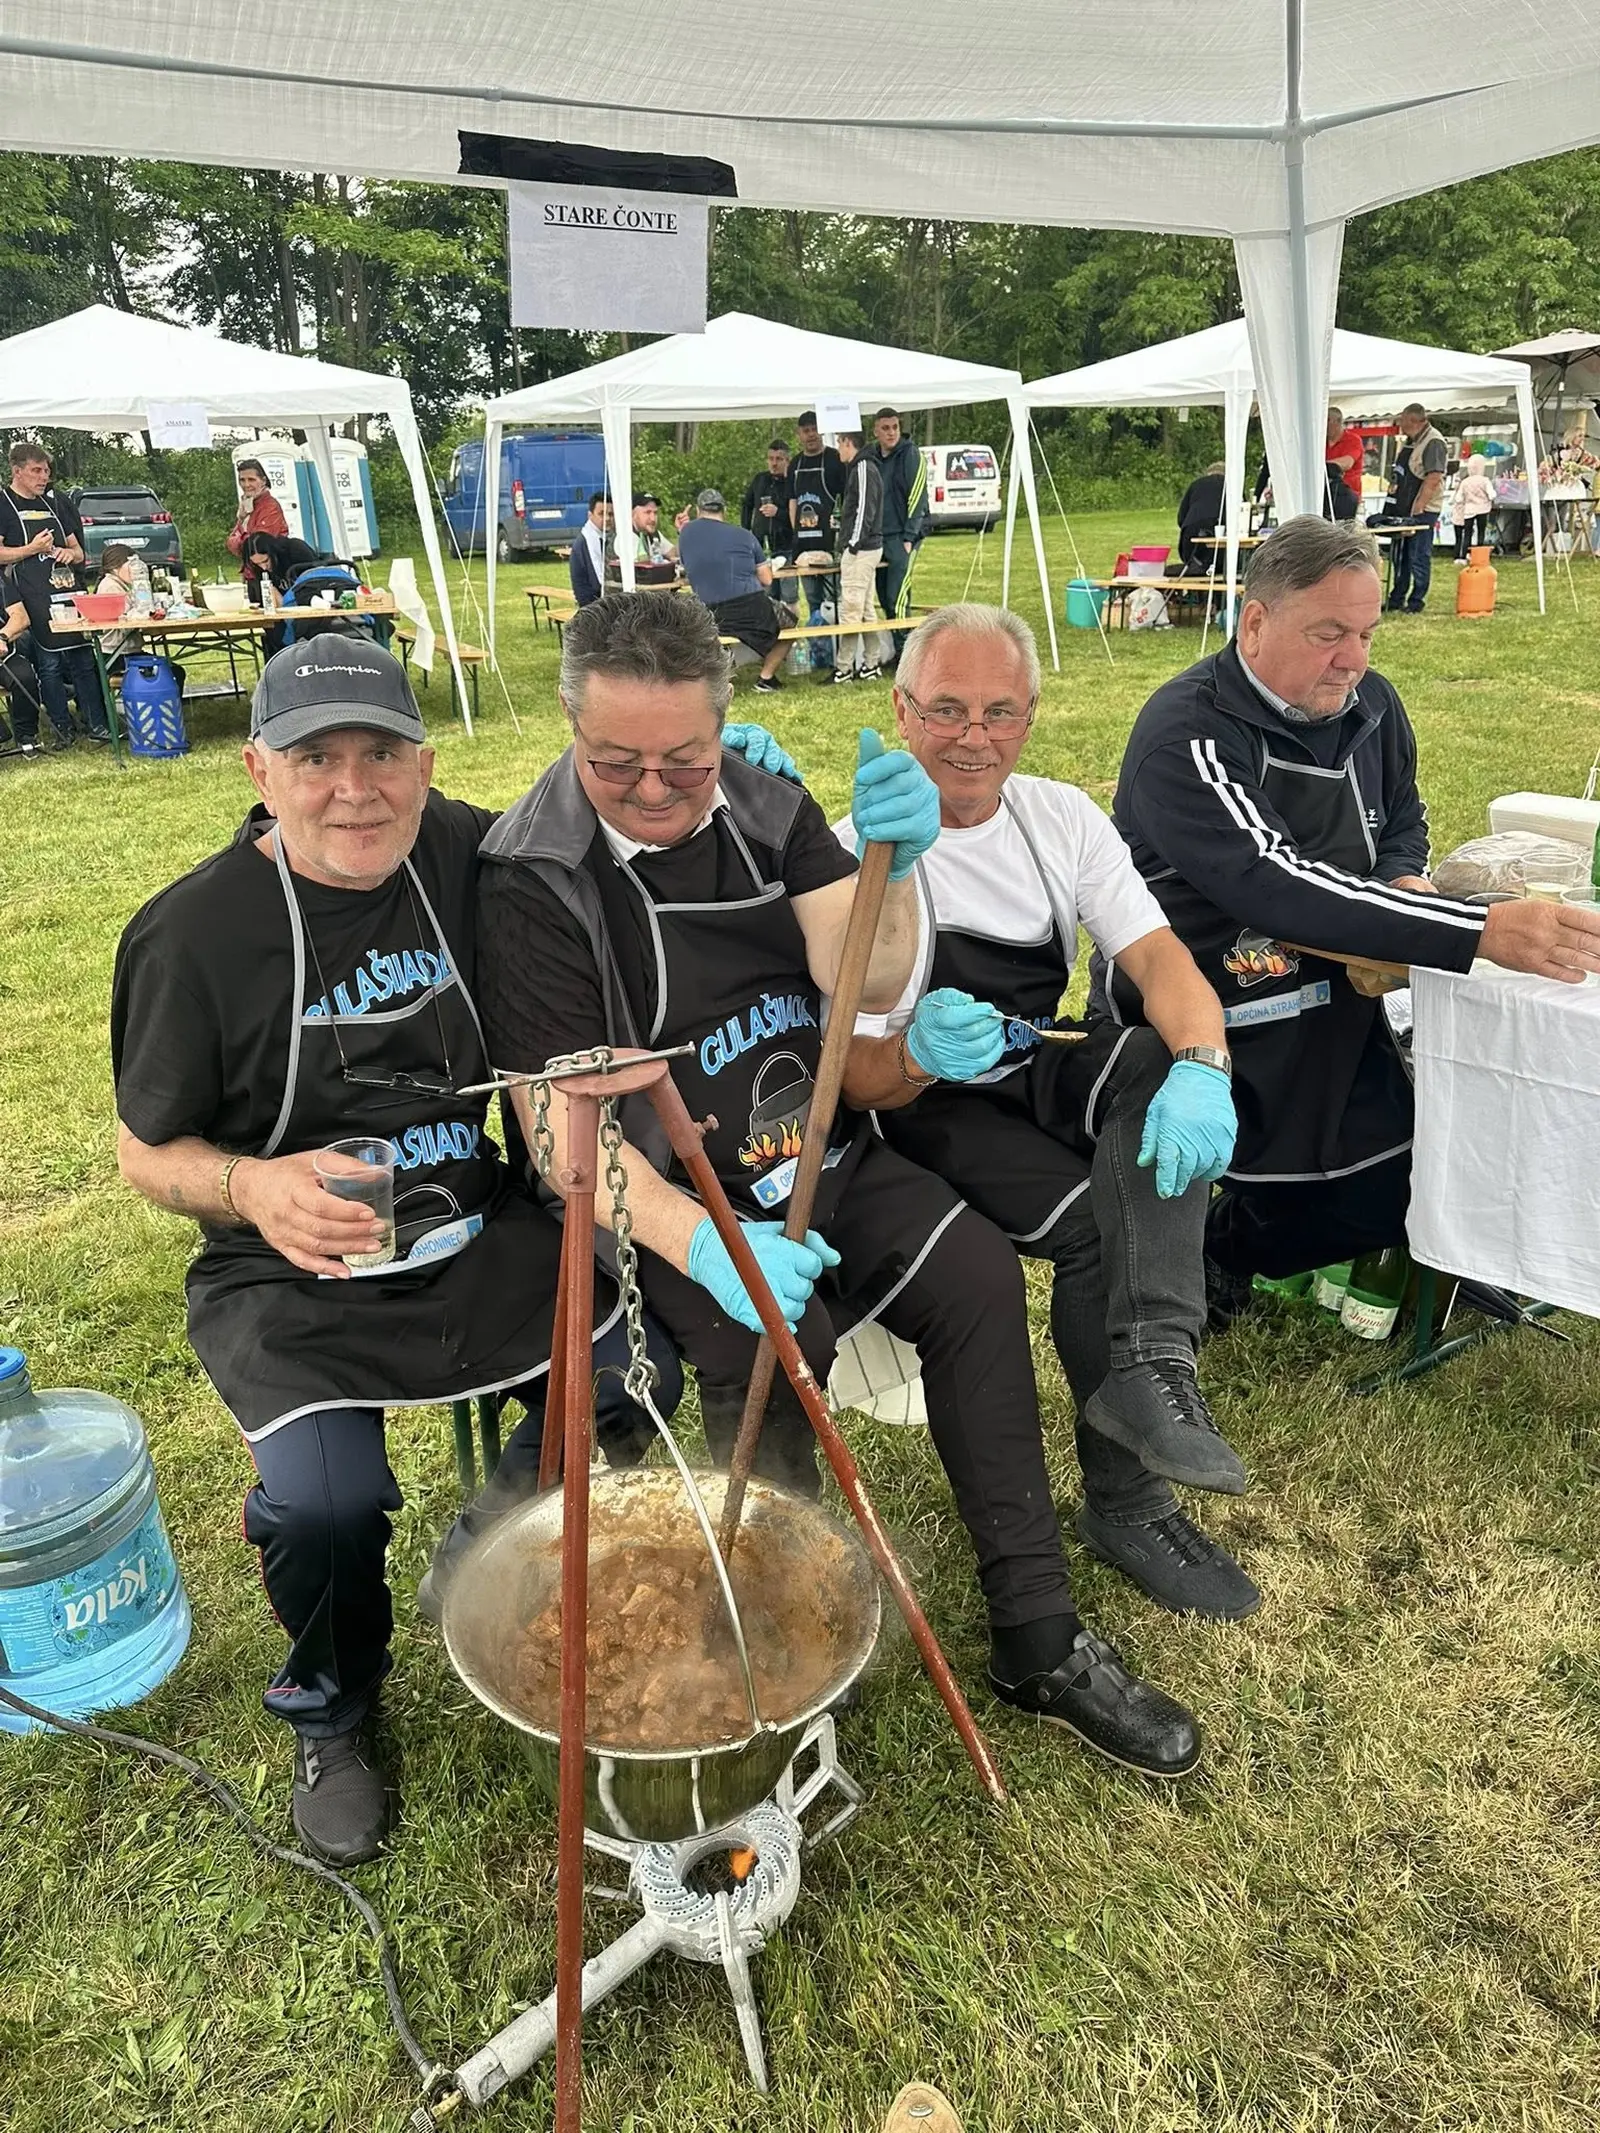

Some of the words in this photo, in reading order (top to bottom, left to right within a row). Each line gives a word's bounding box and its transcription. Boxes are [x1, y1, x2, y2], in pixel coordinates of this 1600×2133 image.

[543, 203, 608, 226] STARE
[612, 204, 678, 230] ČONTE
[294, 664, 383, 678] Champion
[64, 1555, 148, 1631] Kala
